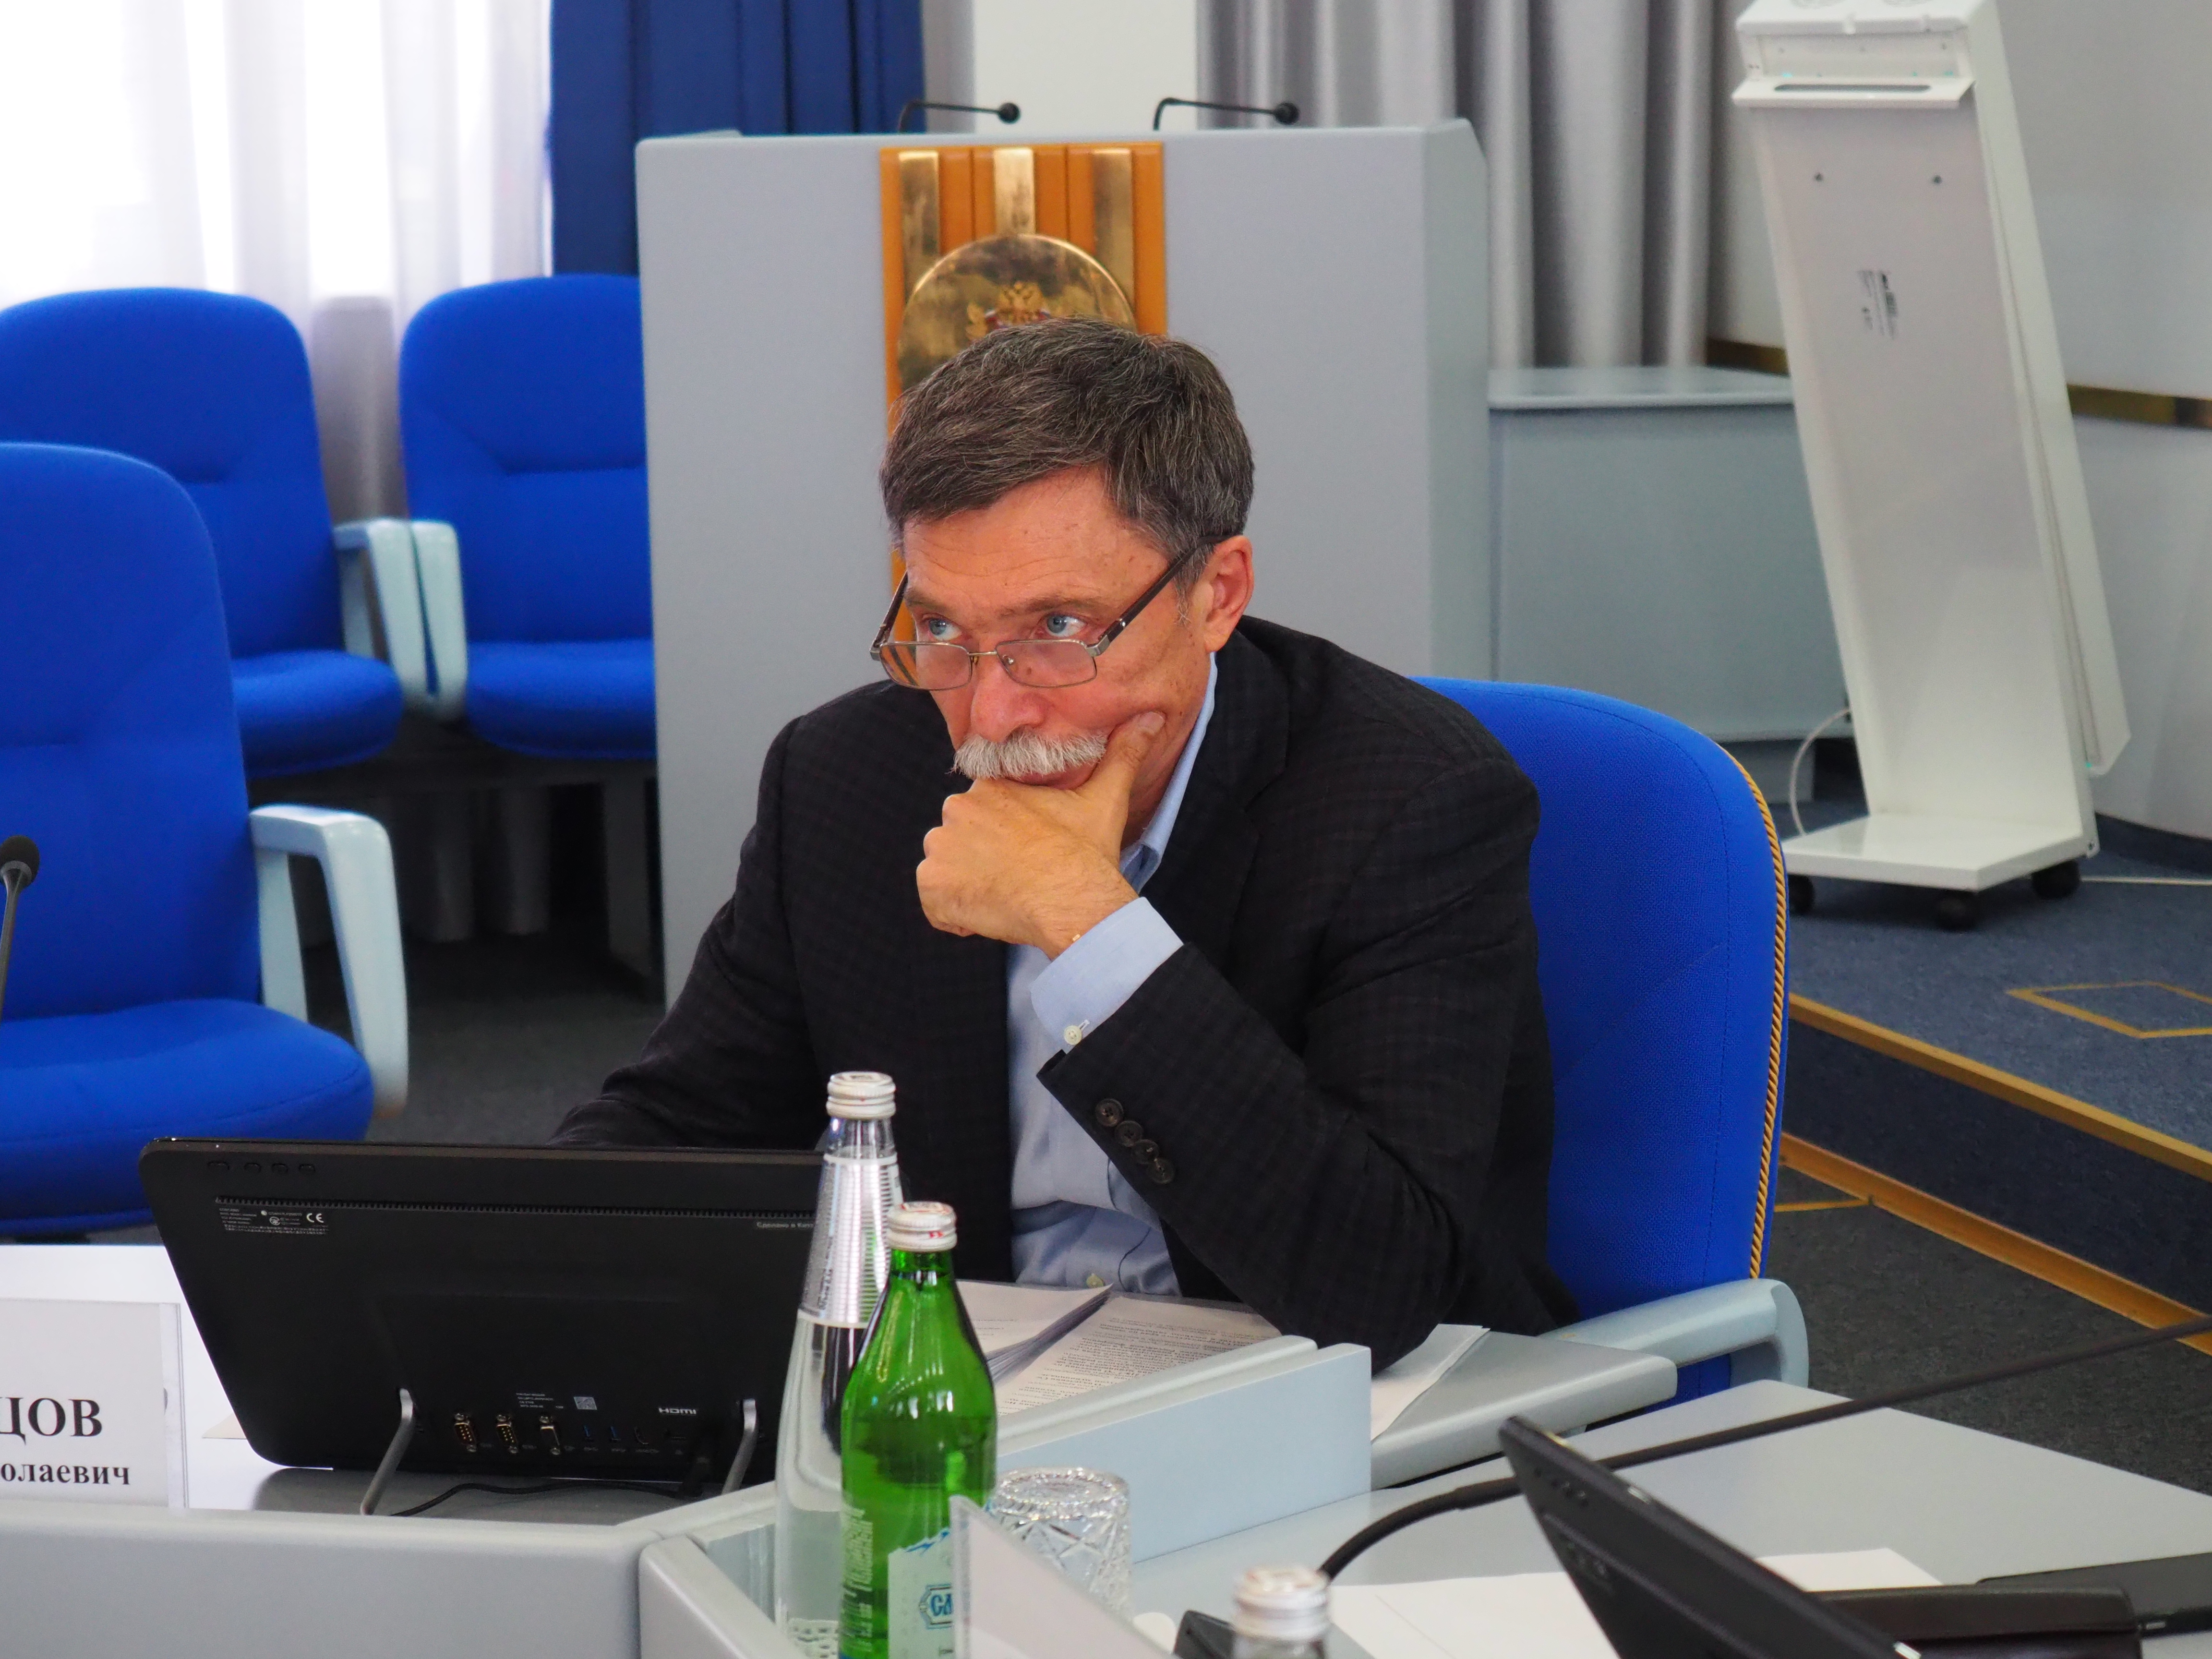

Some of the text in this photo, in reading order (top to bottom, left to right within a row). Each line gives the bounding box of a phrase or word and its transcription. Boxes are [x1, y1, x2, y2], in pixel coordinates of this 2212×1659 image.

[0, 1396, 103, 1446] ЦОВ
[658, 1407, 697, 1415] HDMI
[0, 1463, 130, 1485] олаевич
